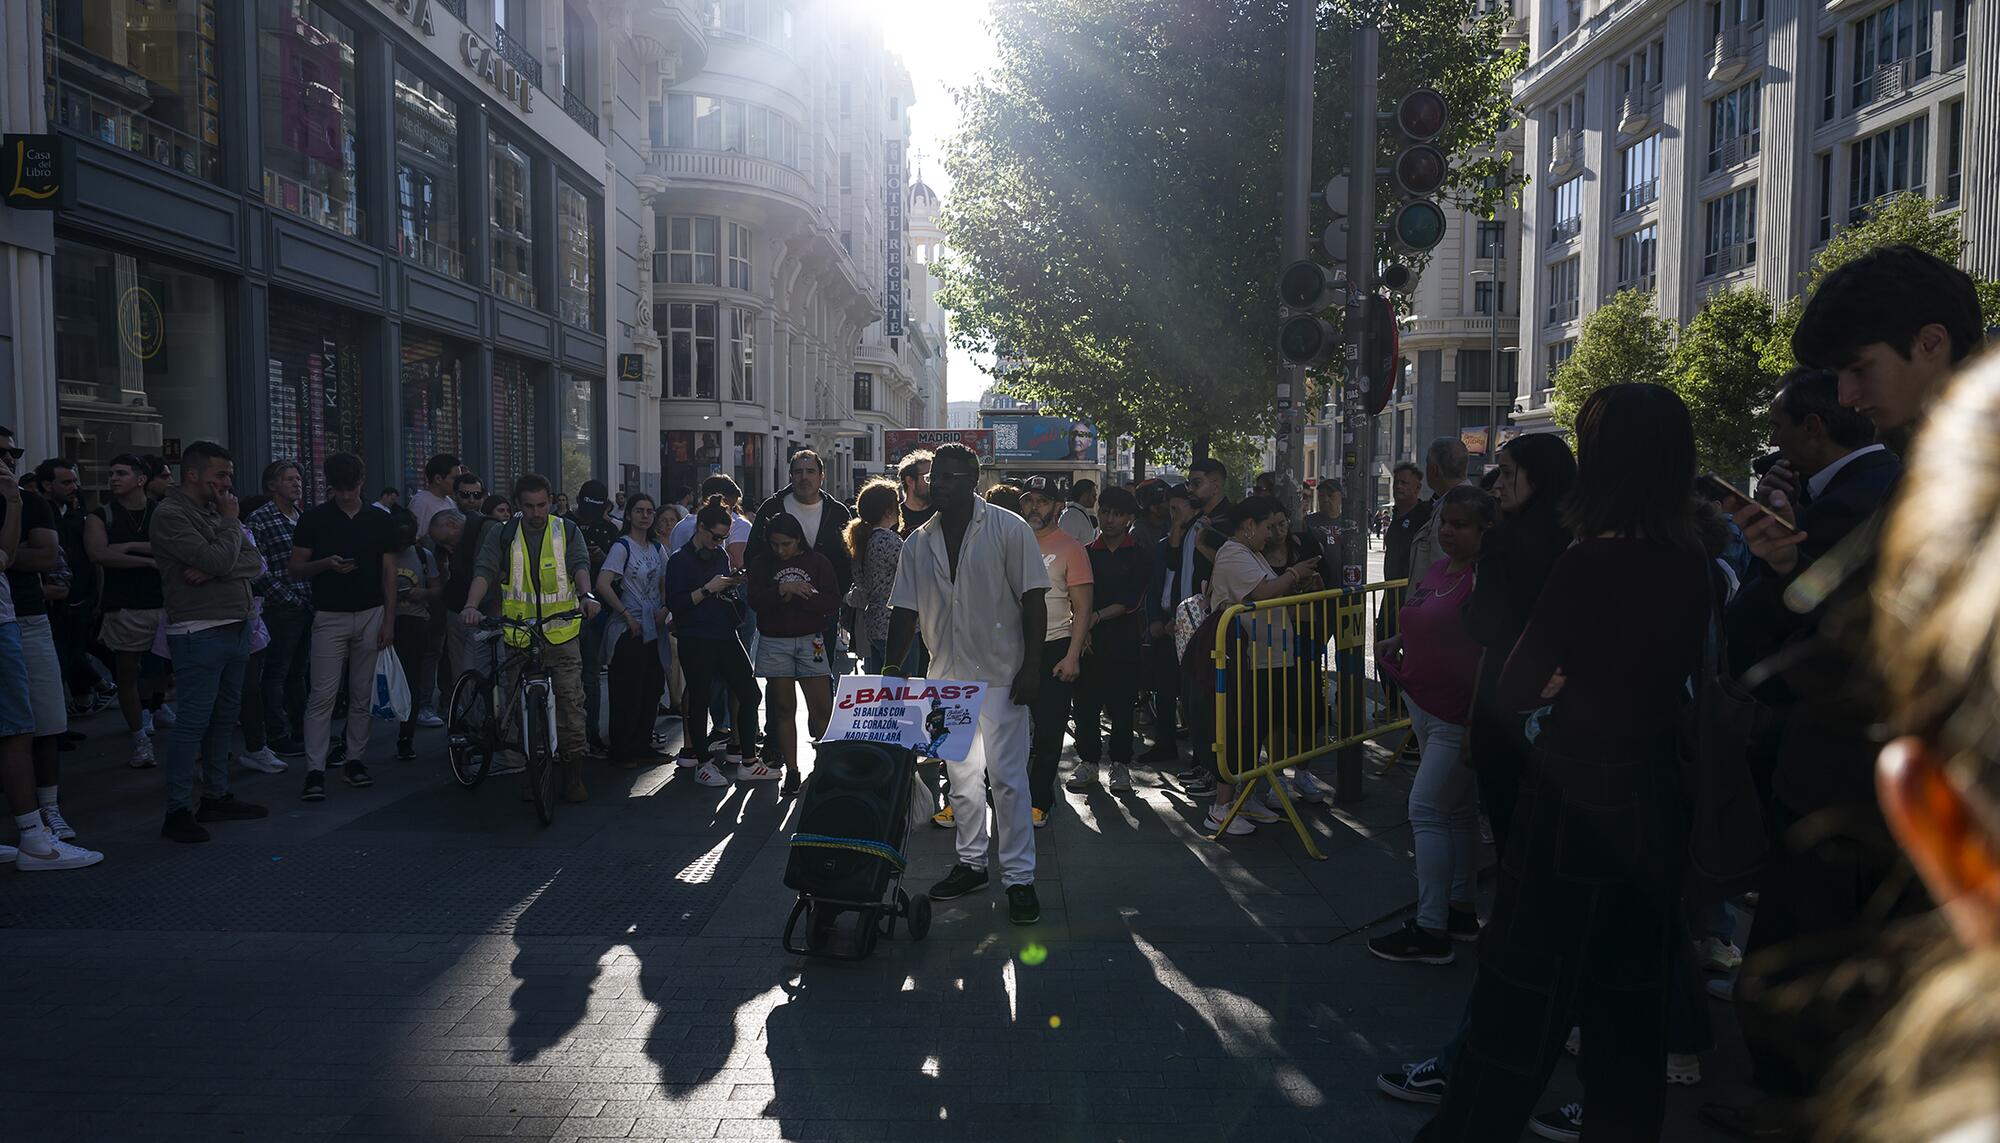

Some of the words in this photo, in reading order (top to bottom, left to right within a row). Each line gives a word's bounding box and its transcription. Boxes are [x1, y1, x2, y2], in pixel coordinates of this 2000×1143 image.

[460, 32, 533, 114] CALPE
[27, 149, 51, 161] Casa
[38, 160, 52, 169] del
[26, 167, 52, 177] Libro
[887, 163, 902, 233] HOTEL
[886, 239, 902, 334] REGENTE
[323, 336, 337, 408] KLIMT
[338, 344, 353, 454] VELAZQUE
[918, 432, 961, 443] MADRID
[838, 685, 980, 710] ¿BAILAS?
[853, 706, 862, 717] SI
[861, 706, 889, 717] BAILAS
[889, 706, 906, 717] CON
[852, 719, 861, 729] EL
[862, 717, 899, 731] CORAZÓN,
[868, 730, 902, 742] BAILARÁ
